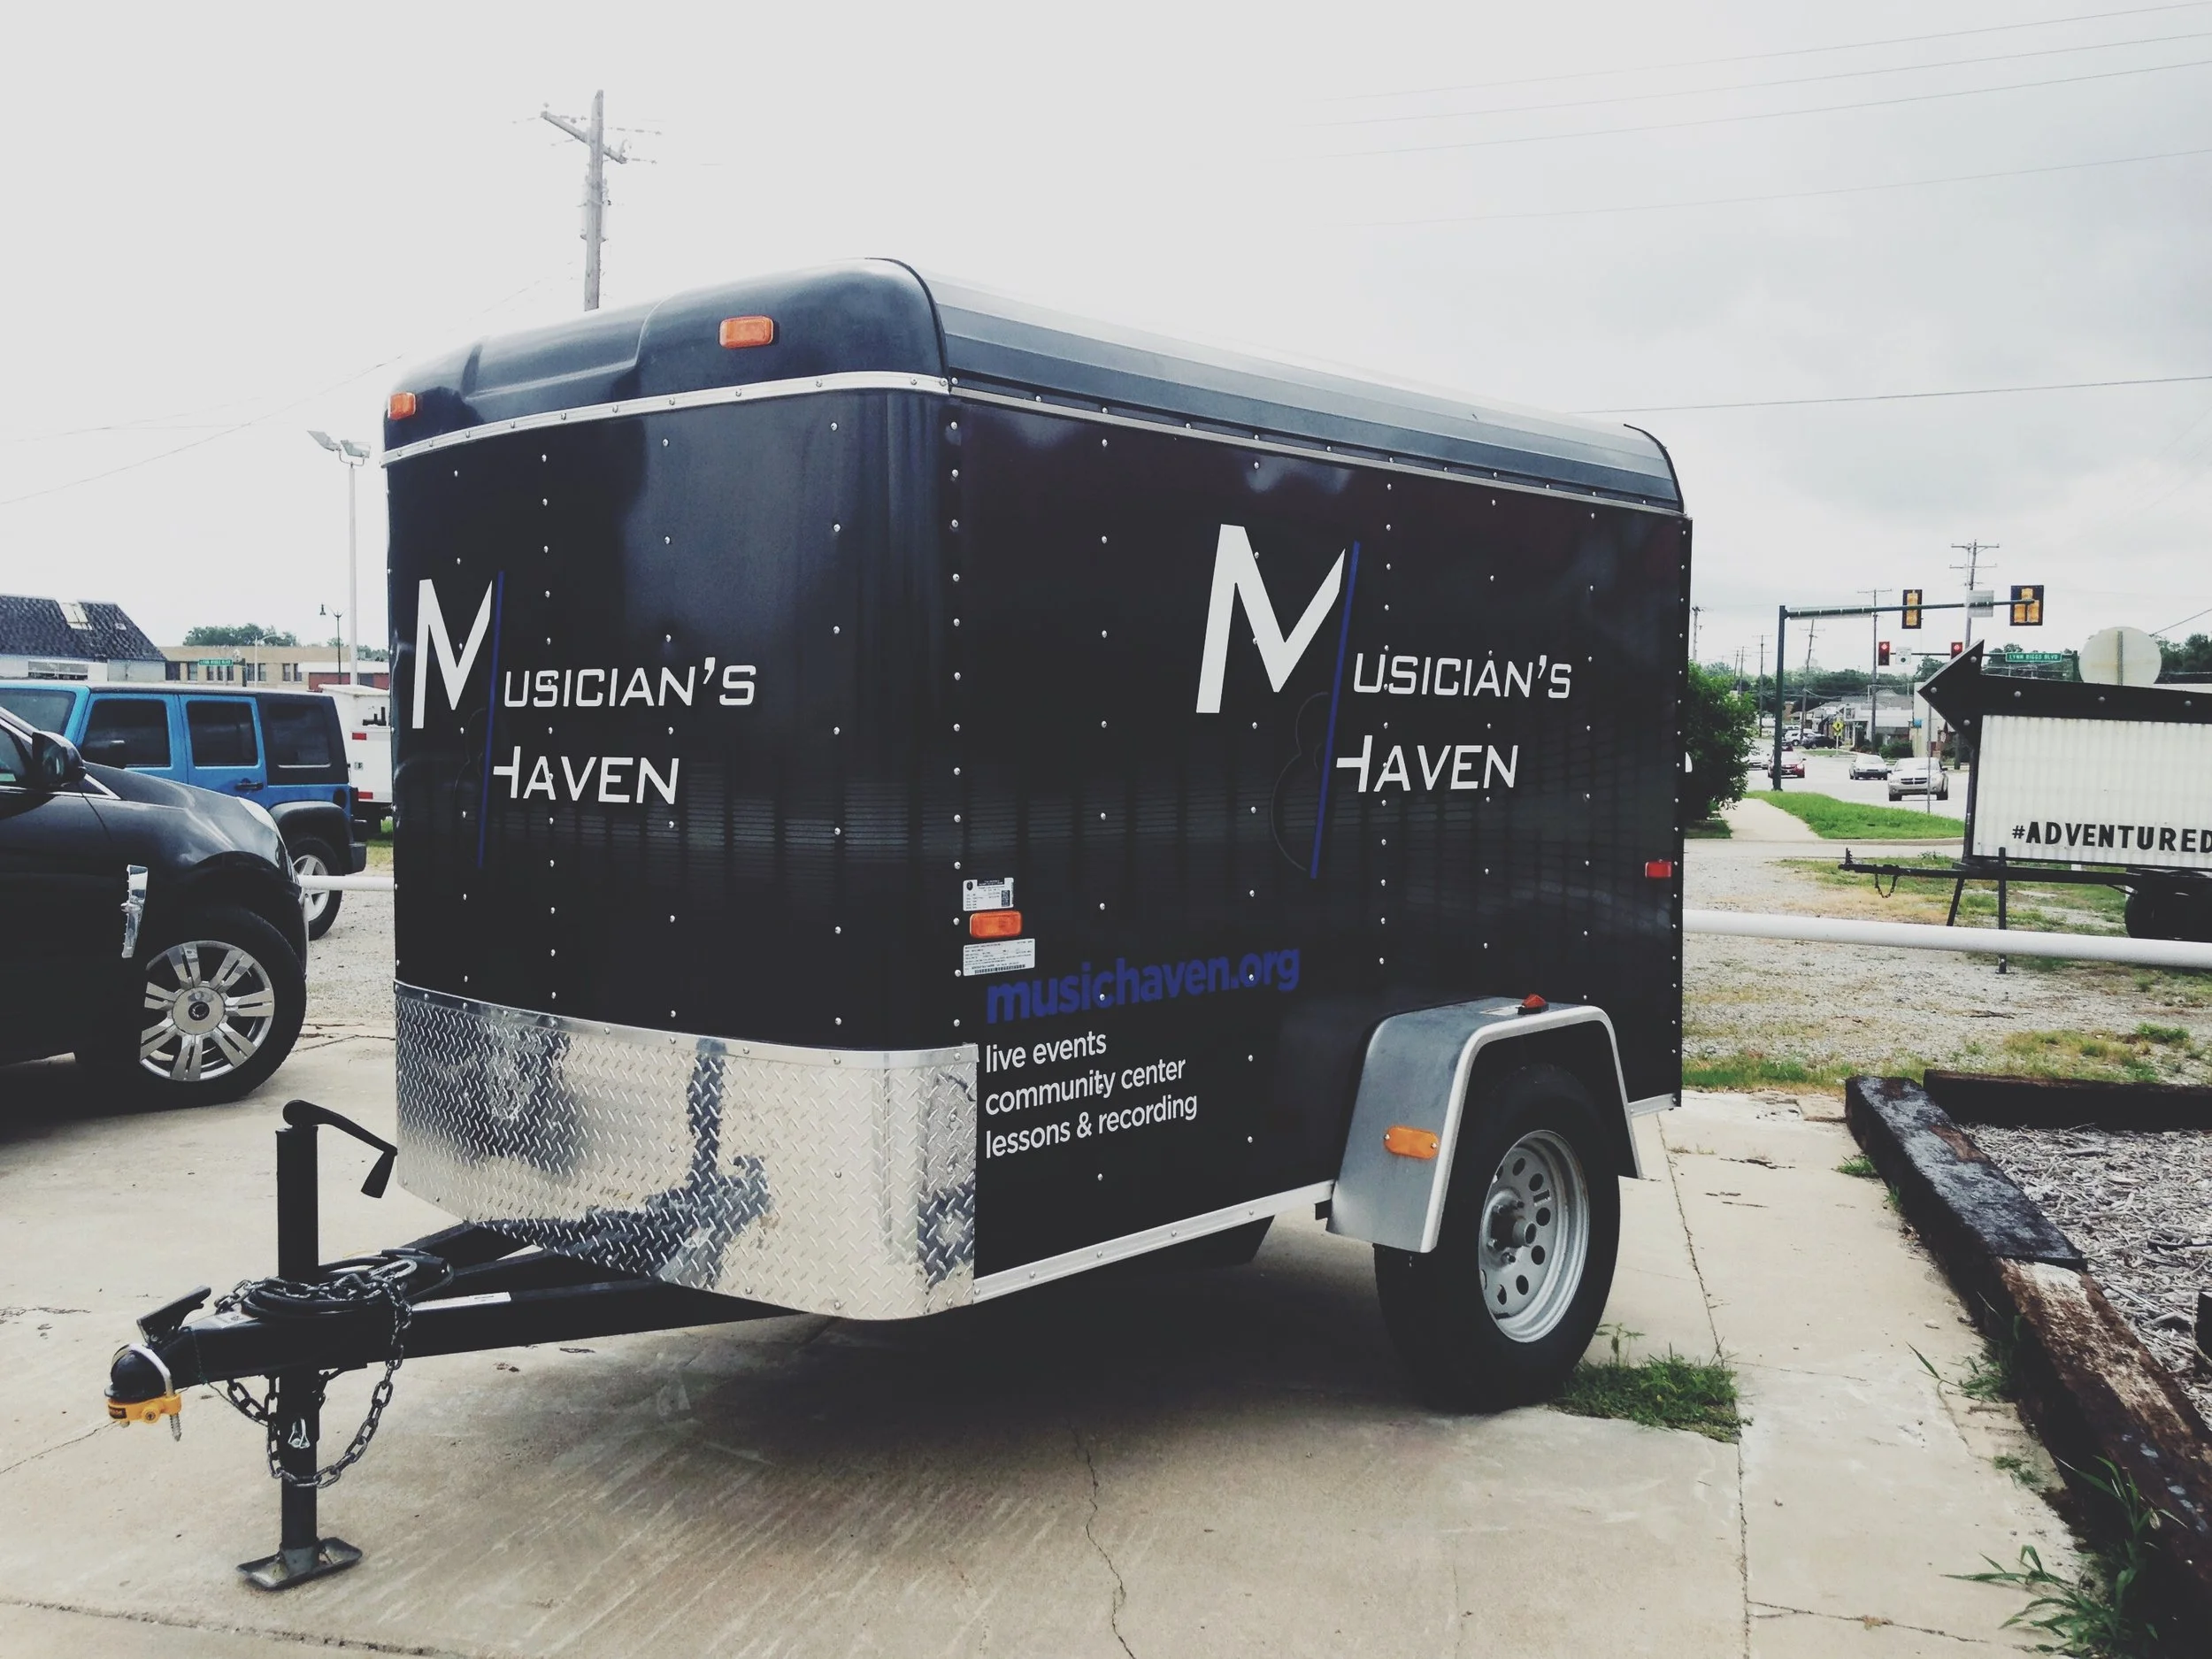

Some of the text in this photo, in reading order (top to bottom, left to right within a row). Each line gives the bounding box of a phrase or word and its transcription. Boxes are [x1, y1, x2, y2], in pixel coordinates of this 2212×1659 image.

[1195, 523, 1572, 714] MUSICIAN'S
[411, 578, 757, 730] MUSICIAN'S
[492, 745, 680, 805] HAVEN
[1335, 734, 1519, 793] HAVEN
[2011, 820, 2212, 854] #ADVENTURED
[986, 948, 1301, 1025] musichaven.org
[985, 1031, 1107, 1073] live events
[985, 1057, 1187, 1116] community center
[985, 1094, 1198, 1159] lessons & recording
